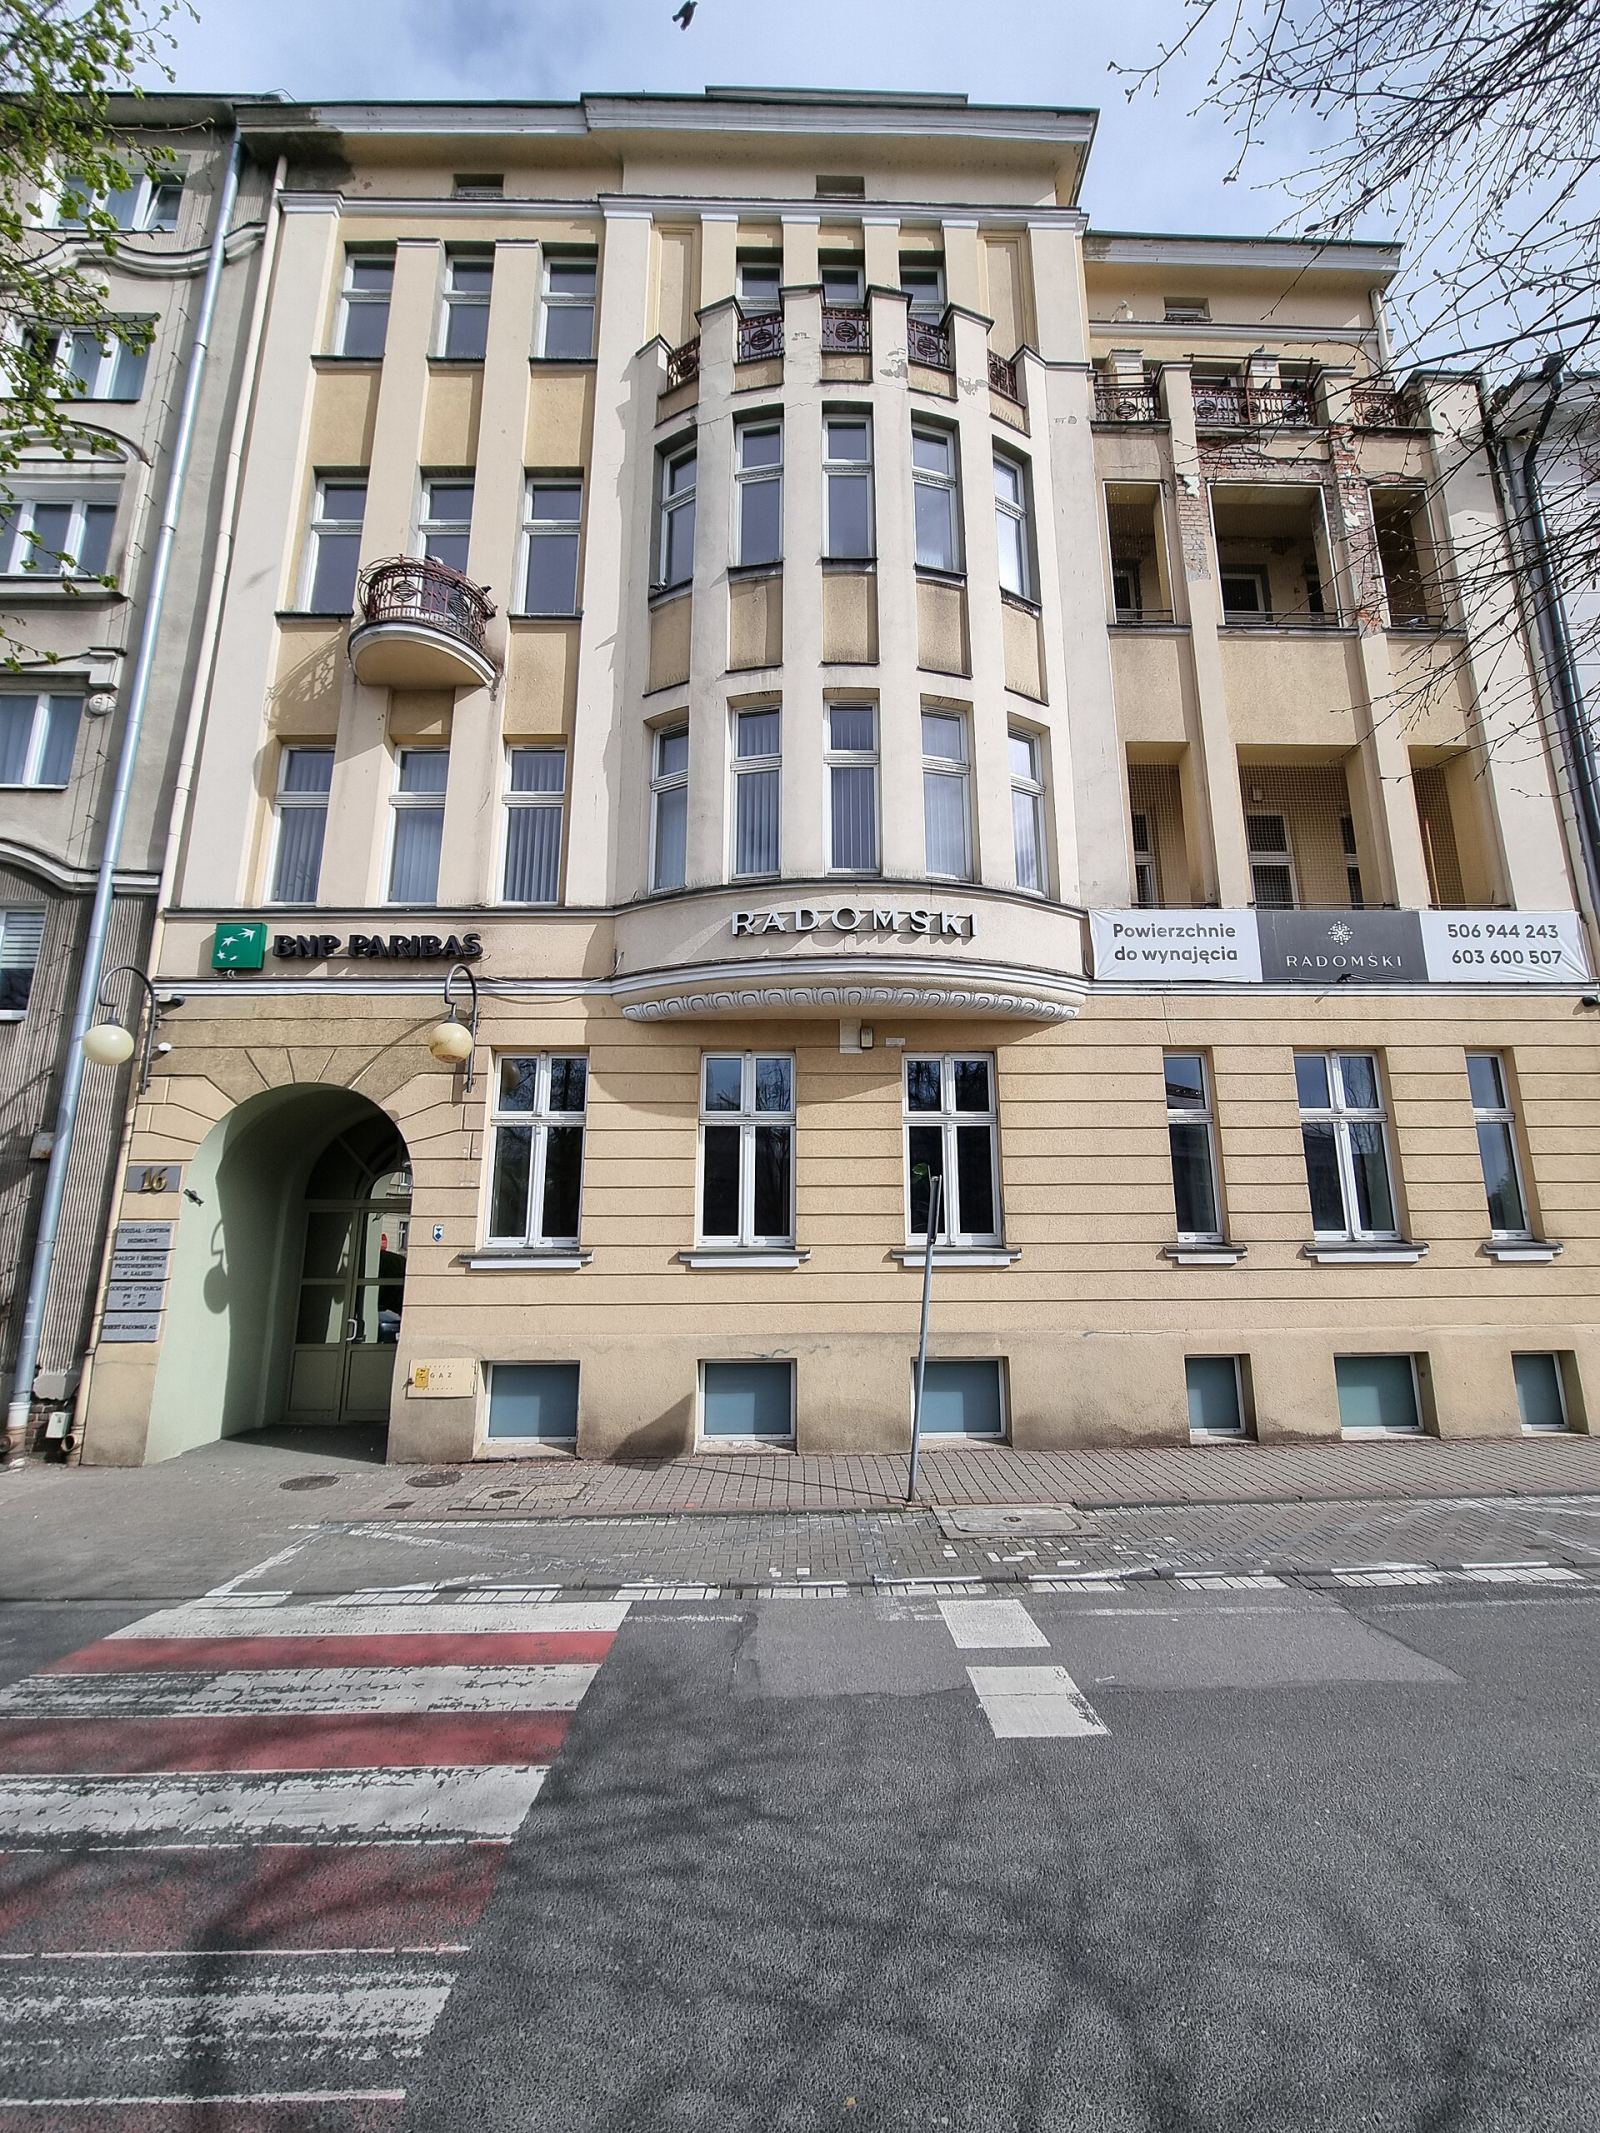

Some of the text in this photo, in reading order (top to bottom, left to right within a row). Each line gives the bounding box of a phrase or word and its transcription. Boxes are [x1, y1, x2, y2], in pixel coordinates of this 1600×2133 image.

[731, 907, 978, 937] RADOMSKI
[1113, 923, 1236, 938] Powierzchnie
[1447, 924, 1559, 939] 506 944 243
[272, 933, 484, 958] BNP PARIBAS
[1114, 946, 1238, 964] do wynajęcia
[1286, 955, 1402, 967] RADOMSKI
[1452, 950, 1563, 965] 603 600 507
[142, 1167, 168, 1191] 16
